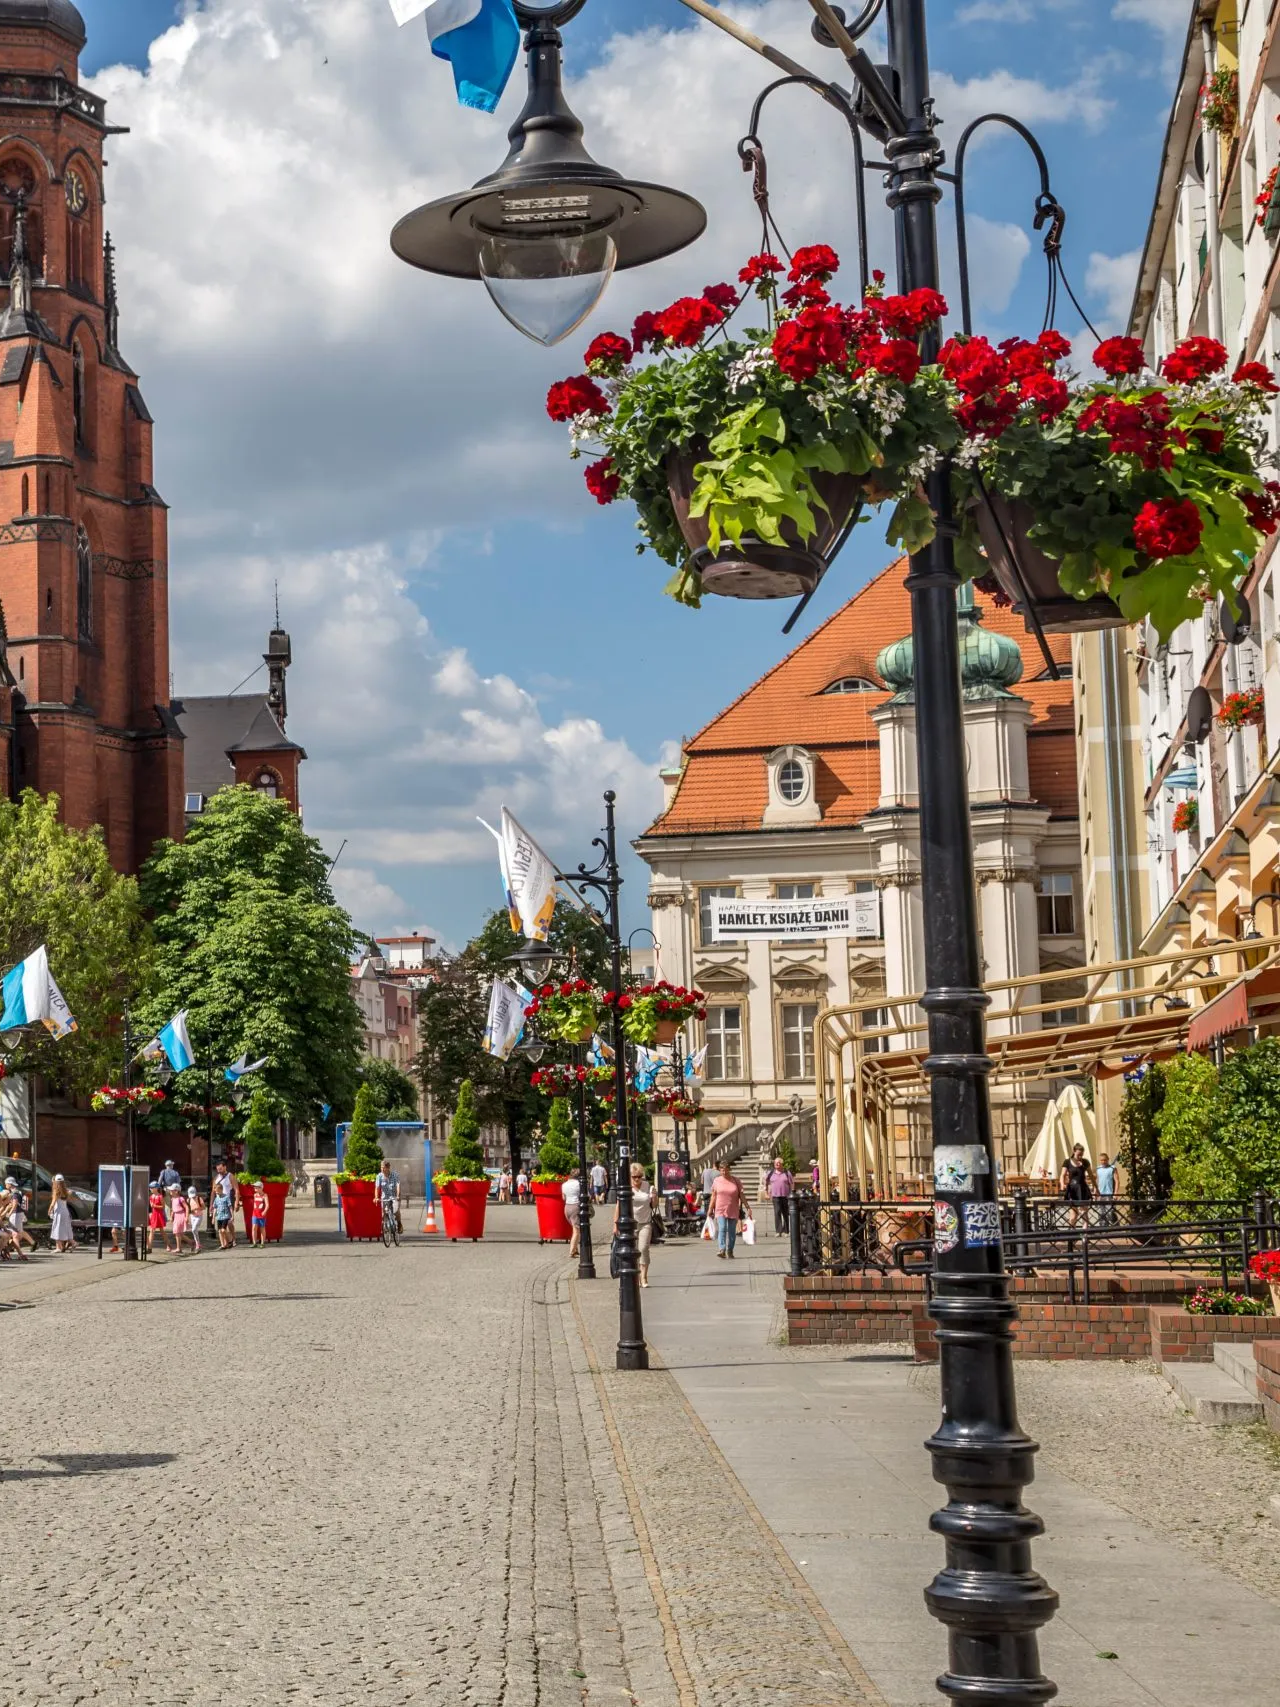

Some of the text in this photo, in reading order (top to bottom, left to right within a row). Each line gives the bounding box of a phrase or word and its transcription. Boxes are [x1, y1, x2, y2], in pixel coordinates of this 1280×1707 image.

[719, 909, 849, 926] HAMLET, KSIĄŻĘ DANII
[48, 985, 66, 1011] NICA
[965, 1202, 997, 1215] EKSTR
